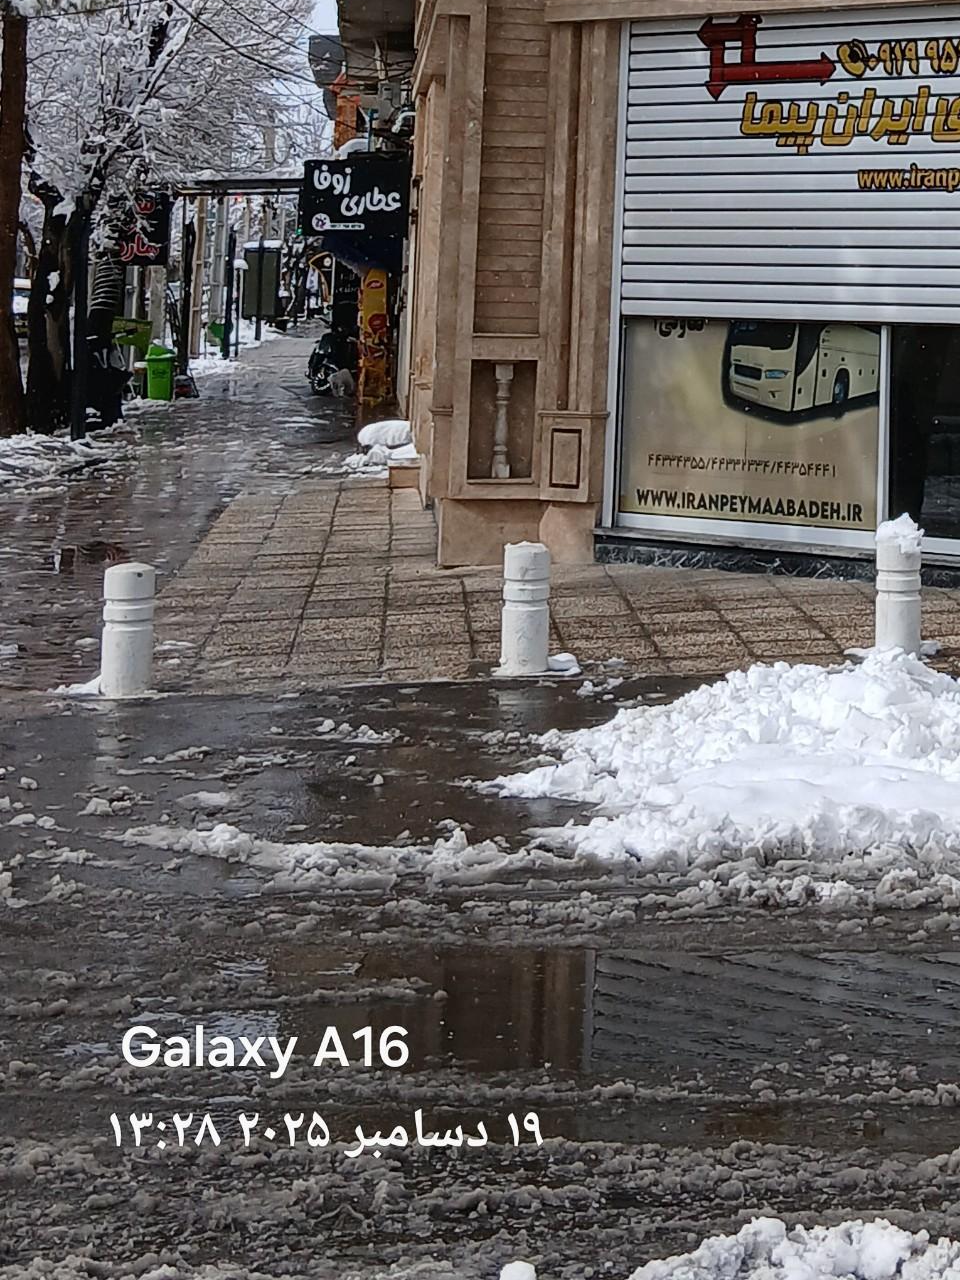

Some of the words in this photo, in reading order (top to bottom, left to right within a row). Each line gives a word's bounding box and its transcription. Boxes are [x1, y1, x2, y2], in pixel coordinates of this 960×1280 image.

[740, 91, 819, 155] پیما
[821, 85, 931, 146] ایران
[314, 165, 352, 195] زوفا
[341, 187, 402, 216] عطاری
[636, 488, 863, 523] WWW.IRANPEYMAABADEH.IR
